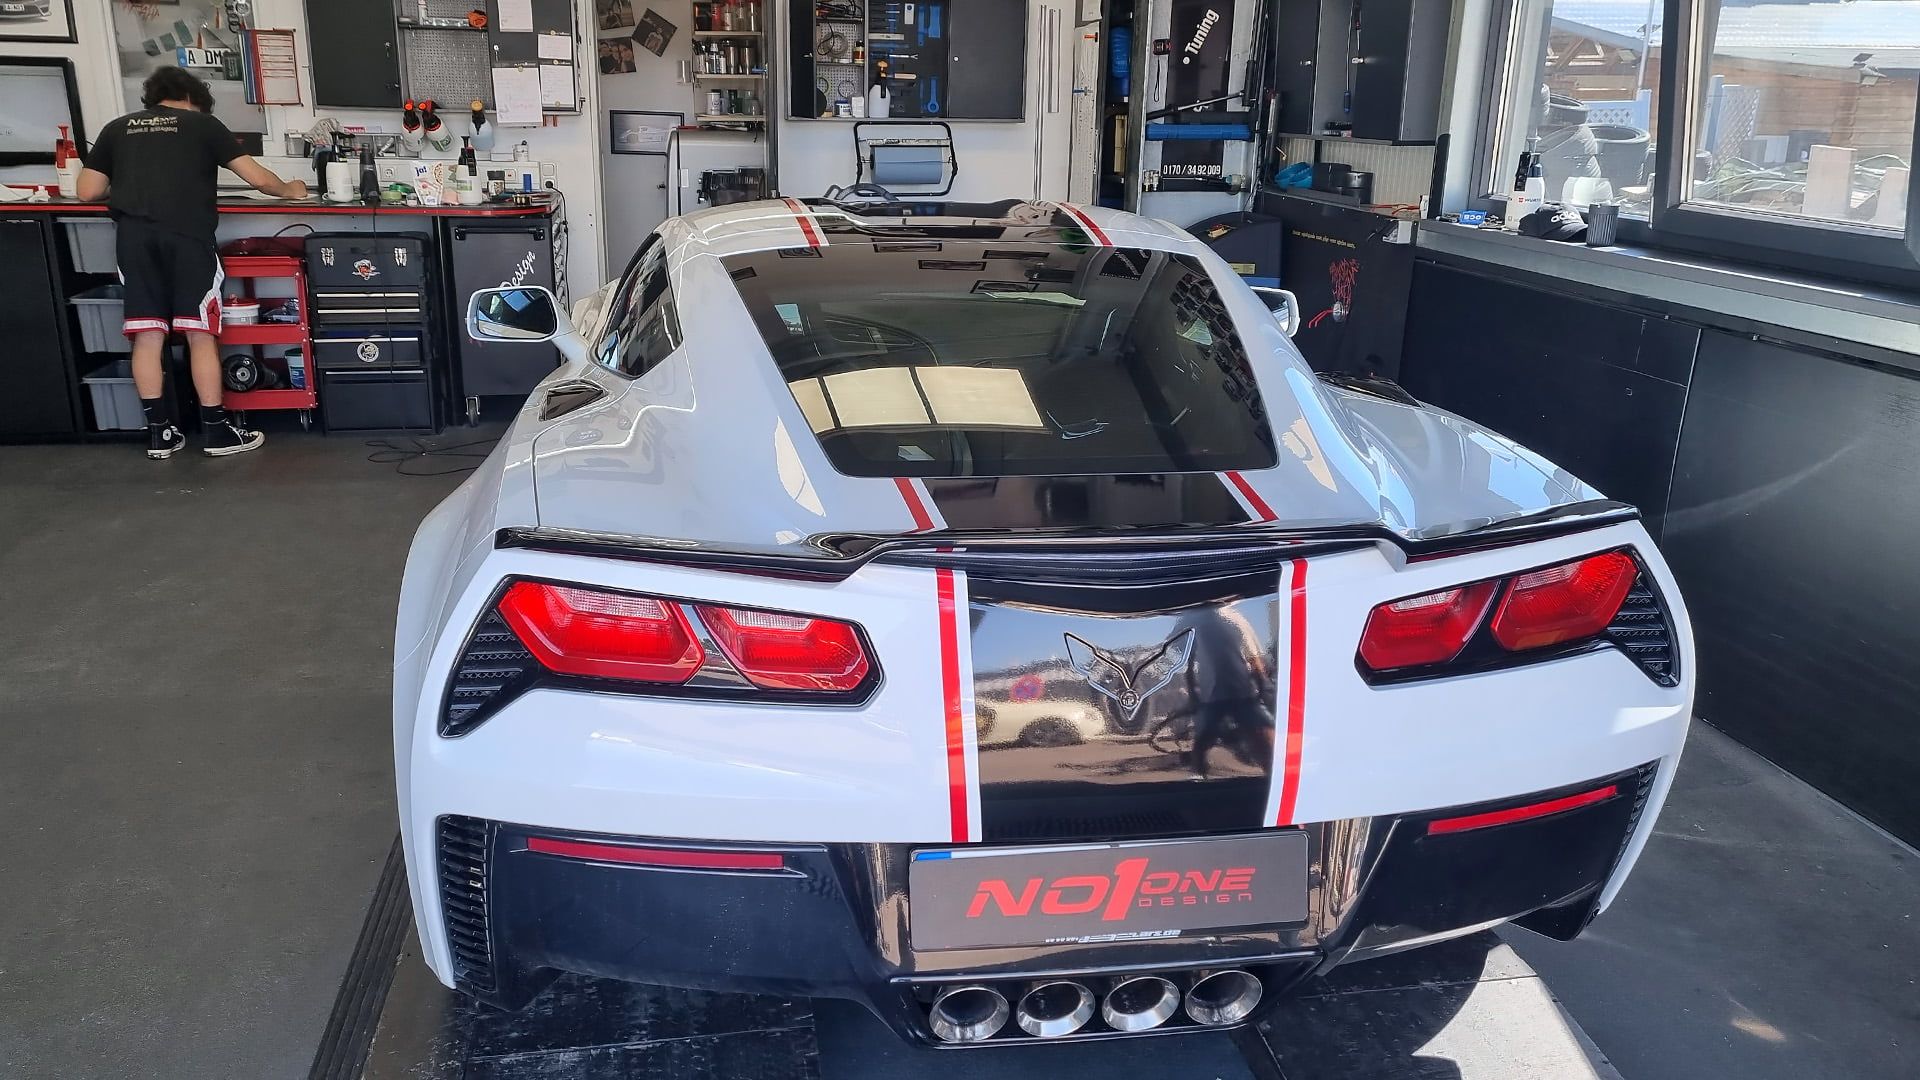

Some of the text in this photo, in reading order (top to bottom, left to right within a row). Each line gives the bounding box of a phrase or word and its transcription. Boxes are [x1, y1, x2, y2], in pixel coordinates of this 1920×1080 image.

[1185, 9, 1220, 55] Tuning
[188, 50, 196, 65] A
[1138, 892, 1252, 907] DESIGN
